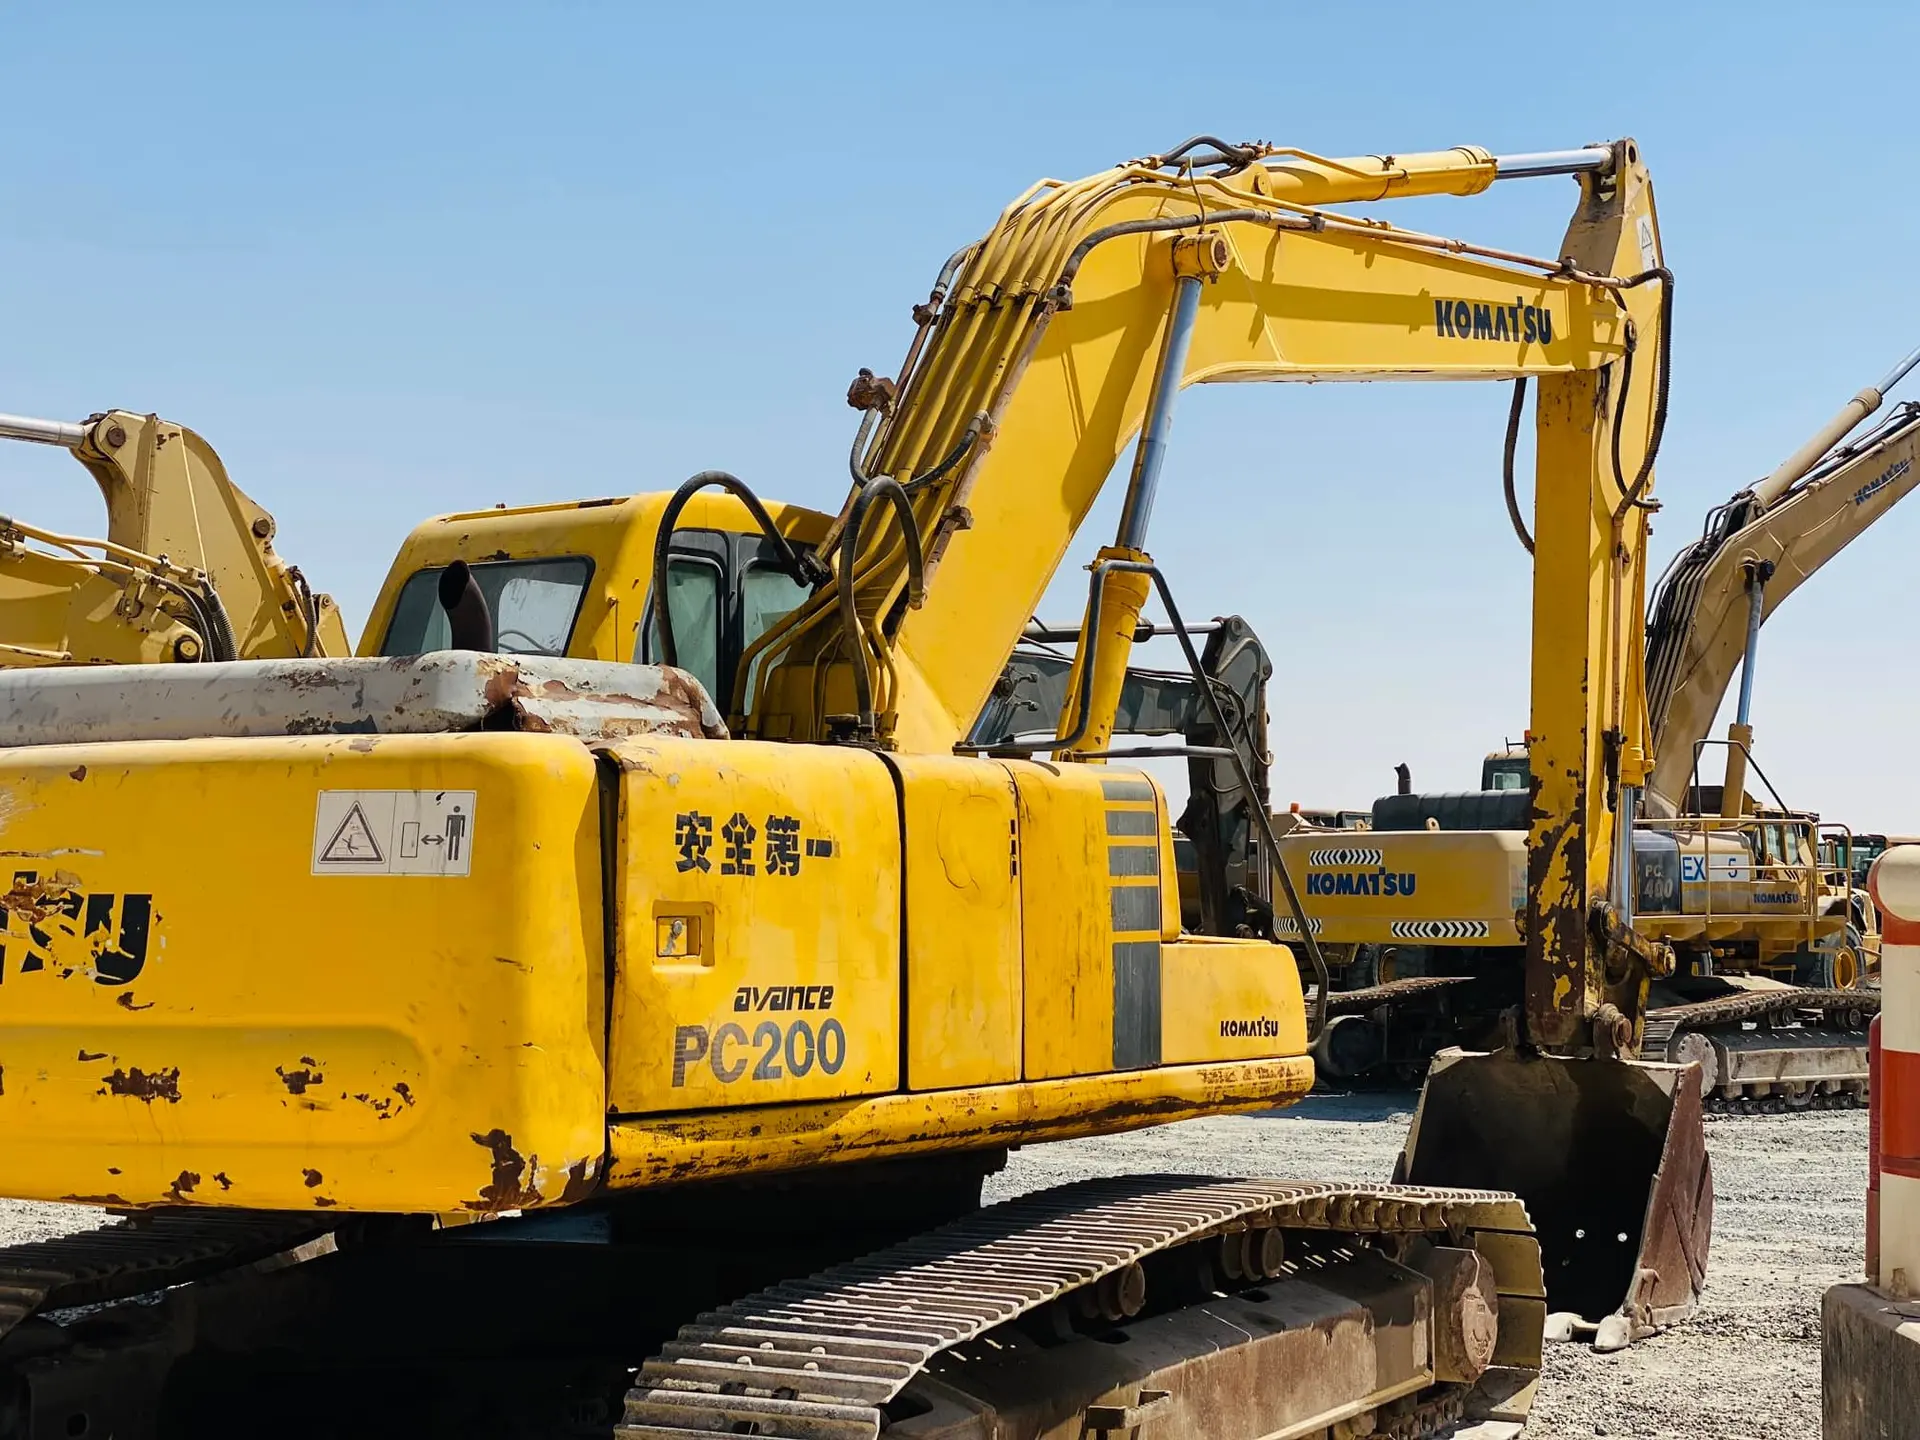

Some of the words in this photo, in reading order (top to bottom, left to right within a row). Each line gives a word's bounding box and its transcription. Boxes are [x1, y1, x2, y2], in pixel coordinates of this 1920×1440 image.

[1435, 296, 1552, 345] KOMATSU
[675, 810, 833, 876] 安全第一
[1306, 867, 1416, 896] KOMATSU
[1682, 856, 1706, 881] EX
[1727, 857, 1738, 878] 5
[1753, 891, 1799, 904] KOMATSU
[734, 985, 834, 1012] avance
[1220, 1015, 1278, 1037] KOMATSU
[672, 1018, 846, 1088] PC200
